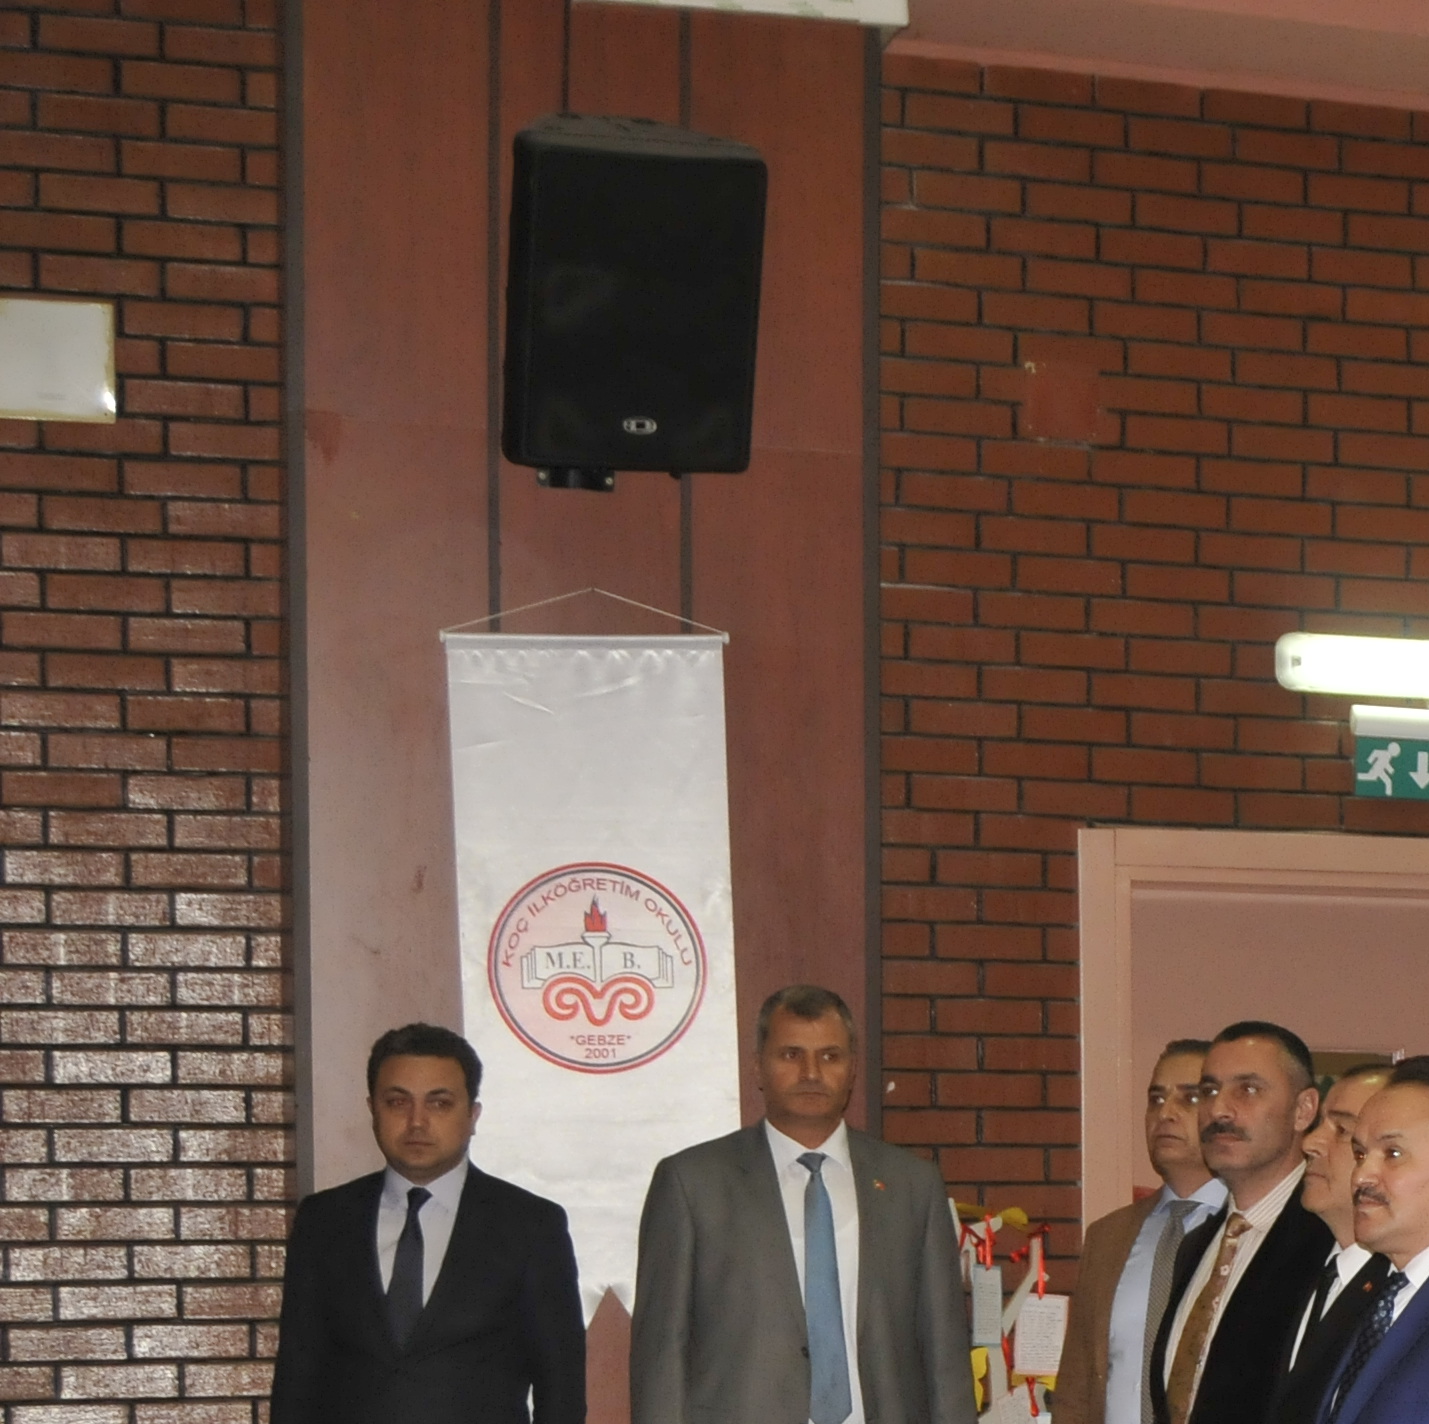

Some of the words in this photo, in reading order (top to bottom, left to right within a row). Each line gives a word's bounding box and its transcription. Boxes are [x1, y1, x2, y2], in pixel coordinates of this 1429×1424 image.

[502, 917, 529, 968] KOÇ
[528, 877, 641, 918] İLKÖĞRETİM
[644, 898, 692, 966] OKULU
[546, 951, 591, 970] M.E.
[622, 951, 641, 970] B.
[584, 1048, 617, 1059] 2001
